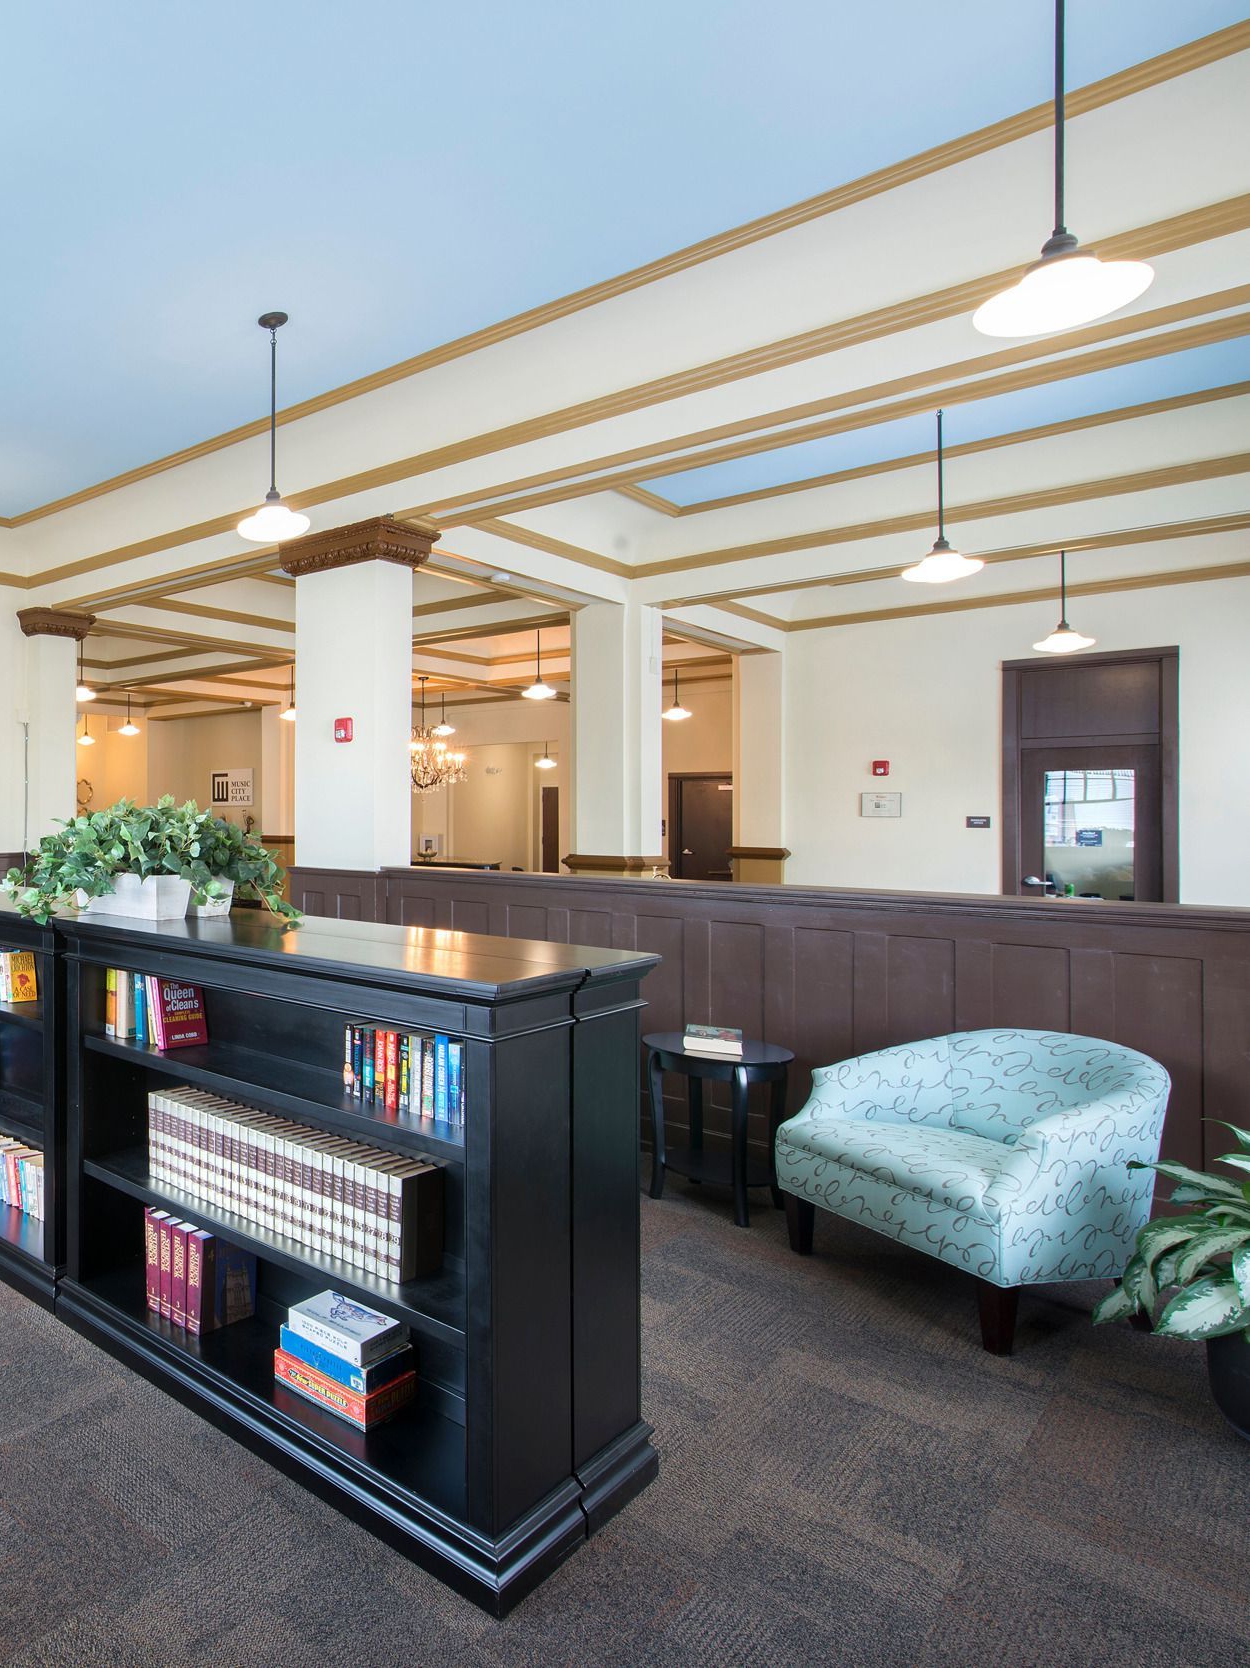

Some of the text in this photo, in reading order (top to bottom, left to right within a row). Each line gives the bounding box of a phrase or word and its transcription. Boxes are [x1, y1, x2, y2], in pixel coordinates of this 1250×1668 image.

[163, 987, 194, 1002] Queen
[166, 1004, 171, 1012] of
[162, 1015, 187, 1023] CLEANING
[163, 1293, 167, 1301] 2
[176, 1300, 180, 1309] 3
[314, 1326, 331, 1337] PIECE
[302, 1324, 348, 1350] SHAPED PUZZLE
